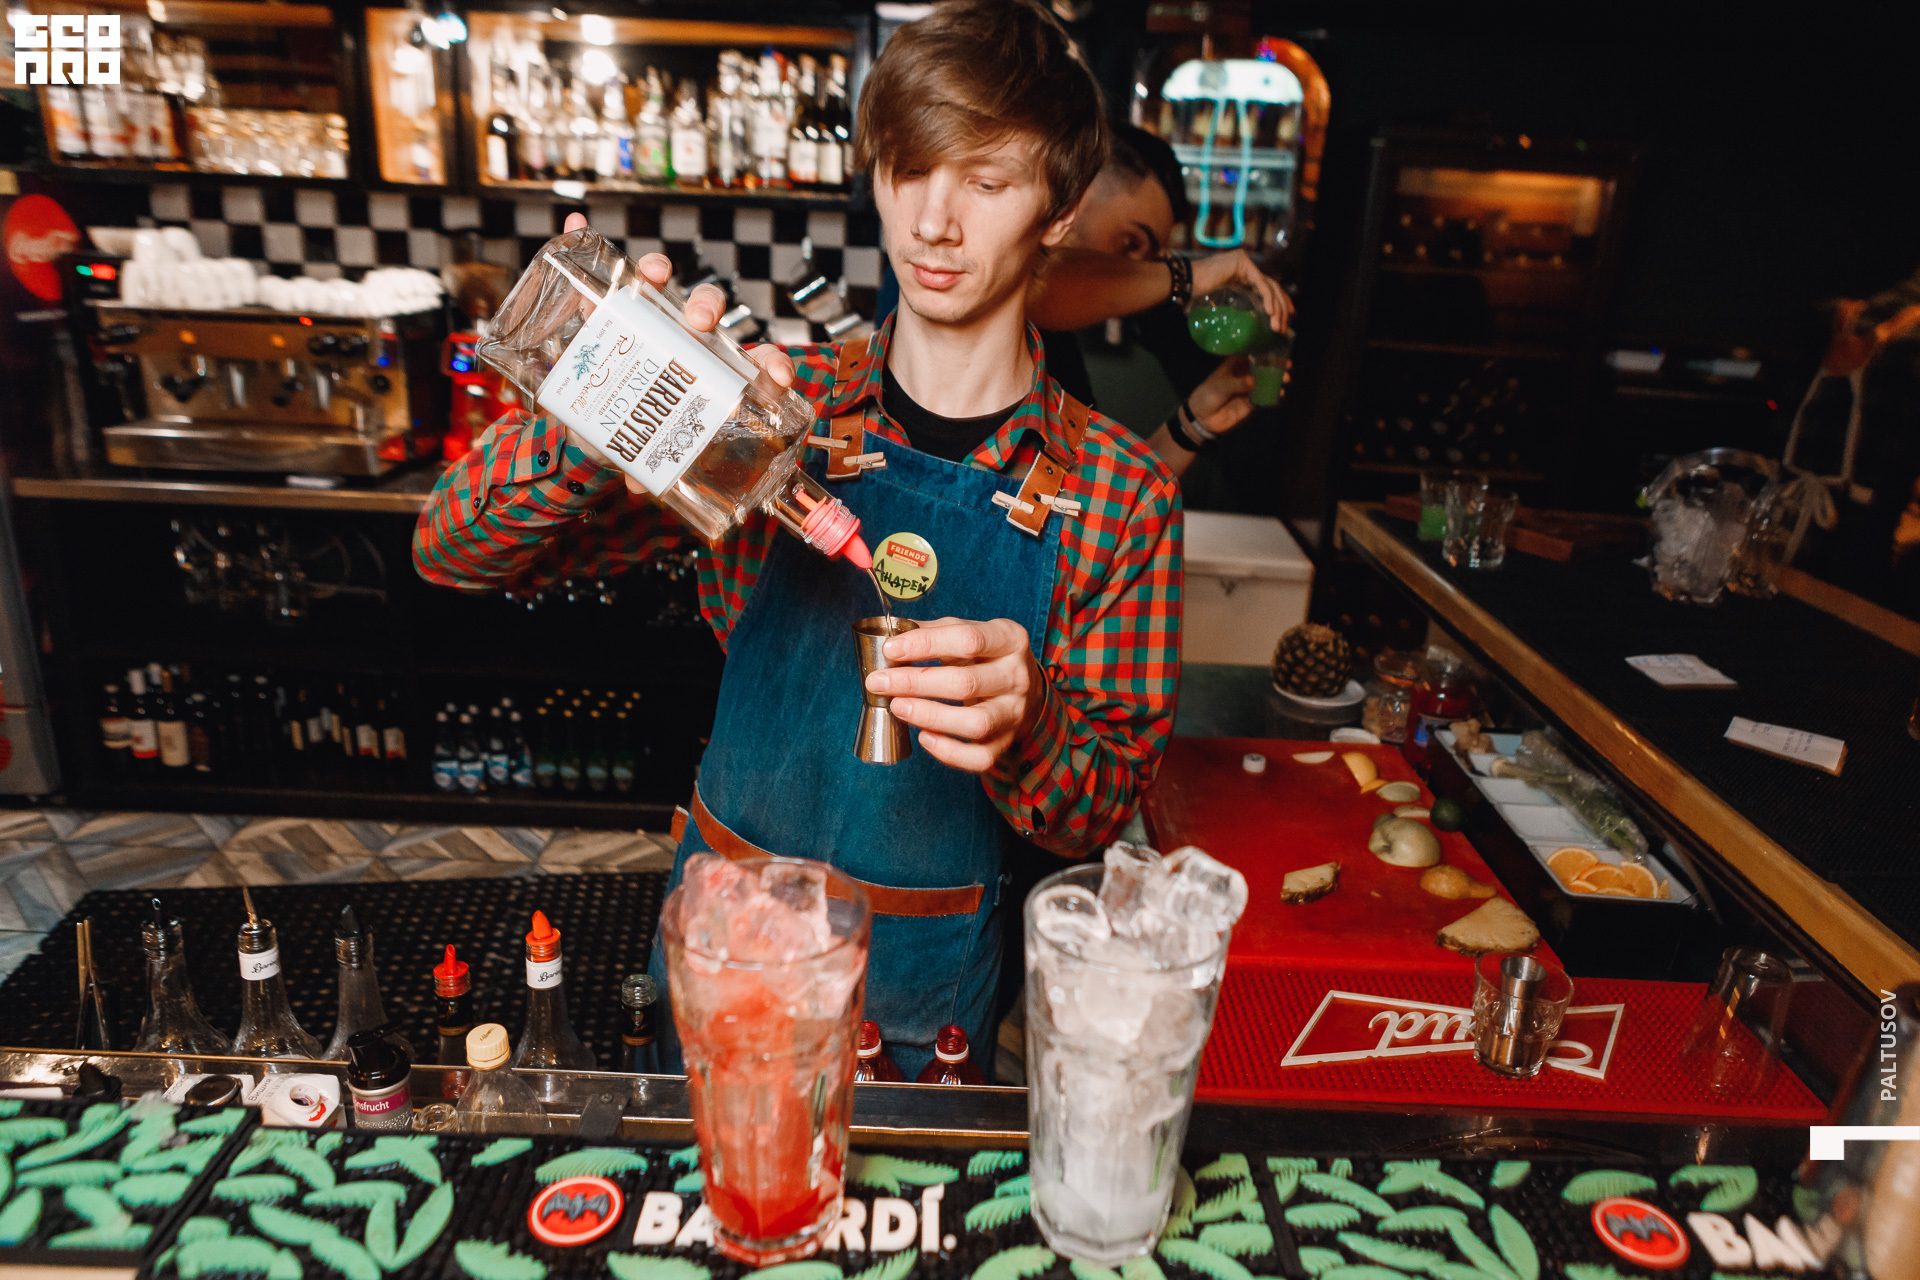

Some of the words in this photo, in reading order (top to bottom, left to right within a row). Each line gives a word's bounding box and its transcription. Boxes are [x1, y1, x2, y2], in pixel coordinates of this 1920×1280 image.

[598, 334, 635, 378] Premium
[615, 358, 641, 391] MASTERLY
[568, 363, 609, 415] Distilled
[627, 358, 659, 397] DRY
[596, 388, 619, 416] CRAFTED
[599, 397, 629, 432] GIN
[605, 359, 695, 462] BARRISTER
[890, 544, 926, 562] FRIENDS
